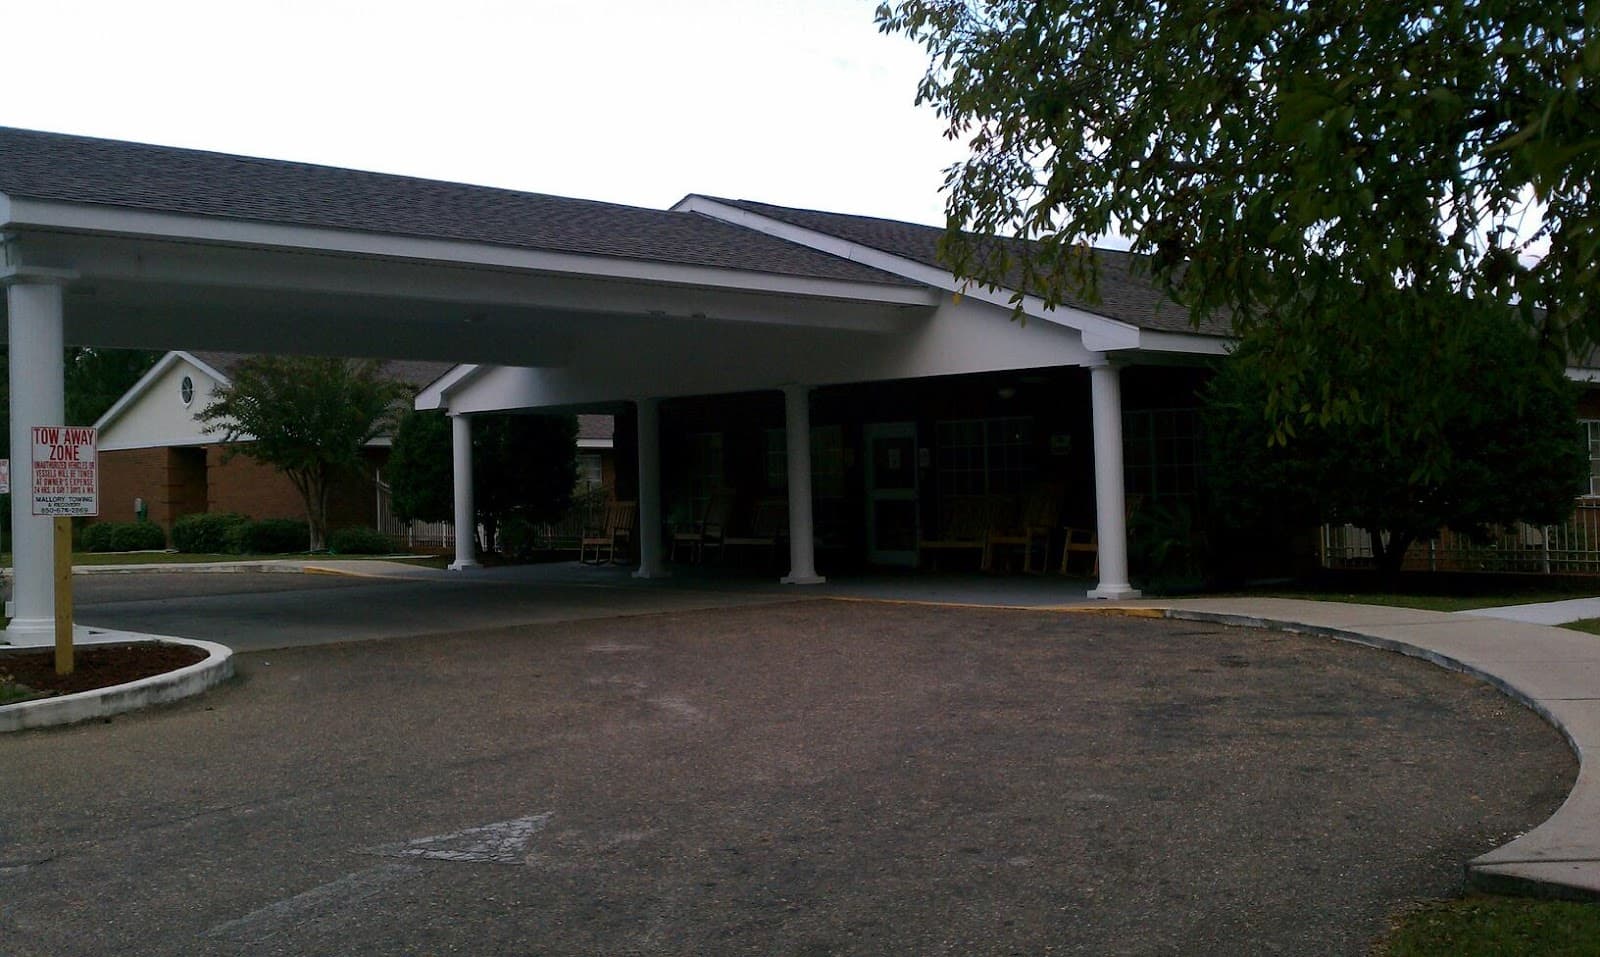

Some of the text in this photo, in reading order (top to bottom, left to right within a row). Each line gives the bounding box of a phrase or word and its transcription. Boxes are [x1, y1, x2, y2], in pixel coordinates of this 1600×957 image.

[34, 428, 94, 445] TOW AWAY
[49, 445, 79, 461] ZONE
[36, 478, 42, 486] AT
[69, 478, 94, 486] EXPENSE
